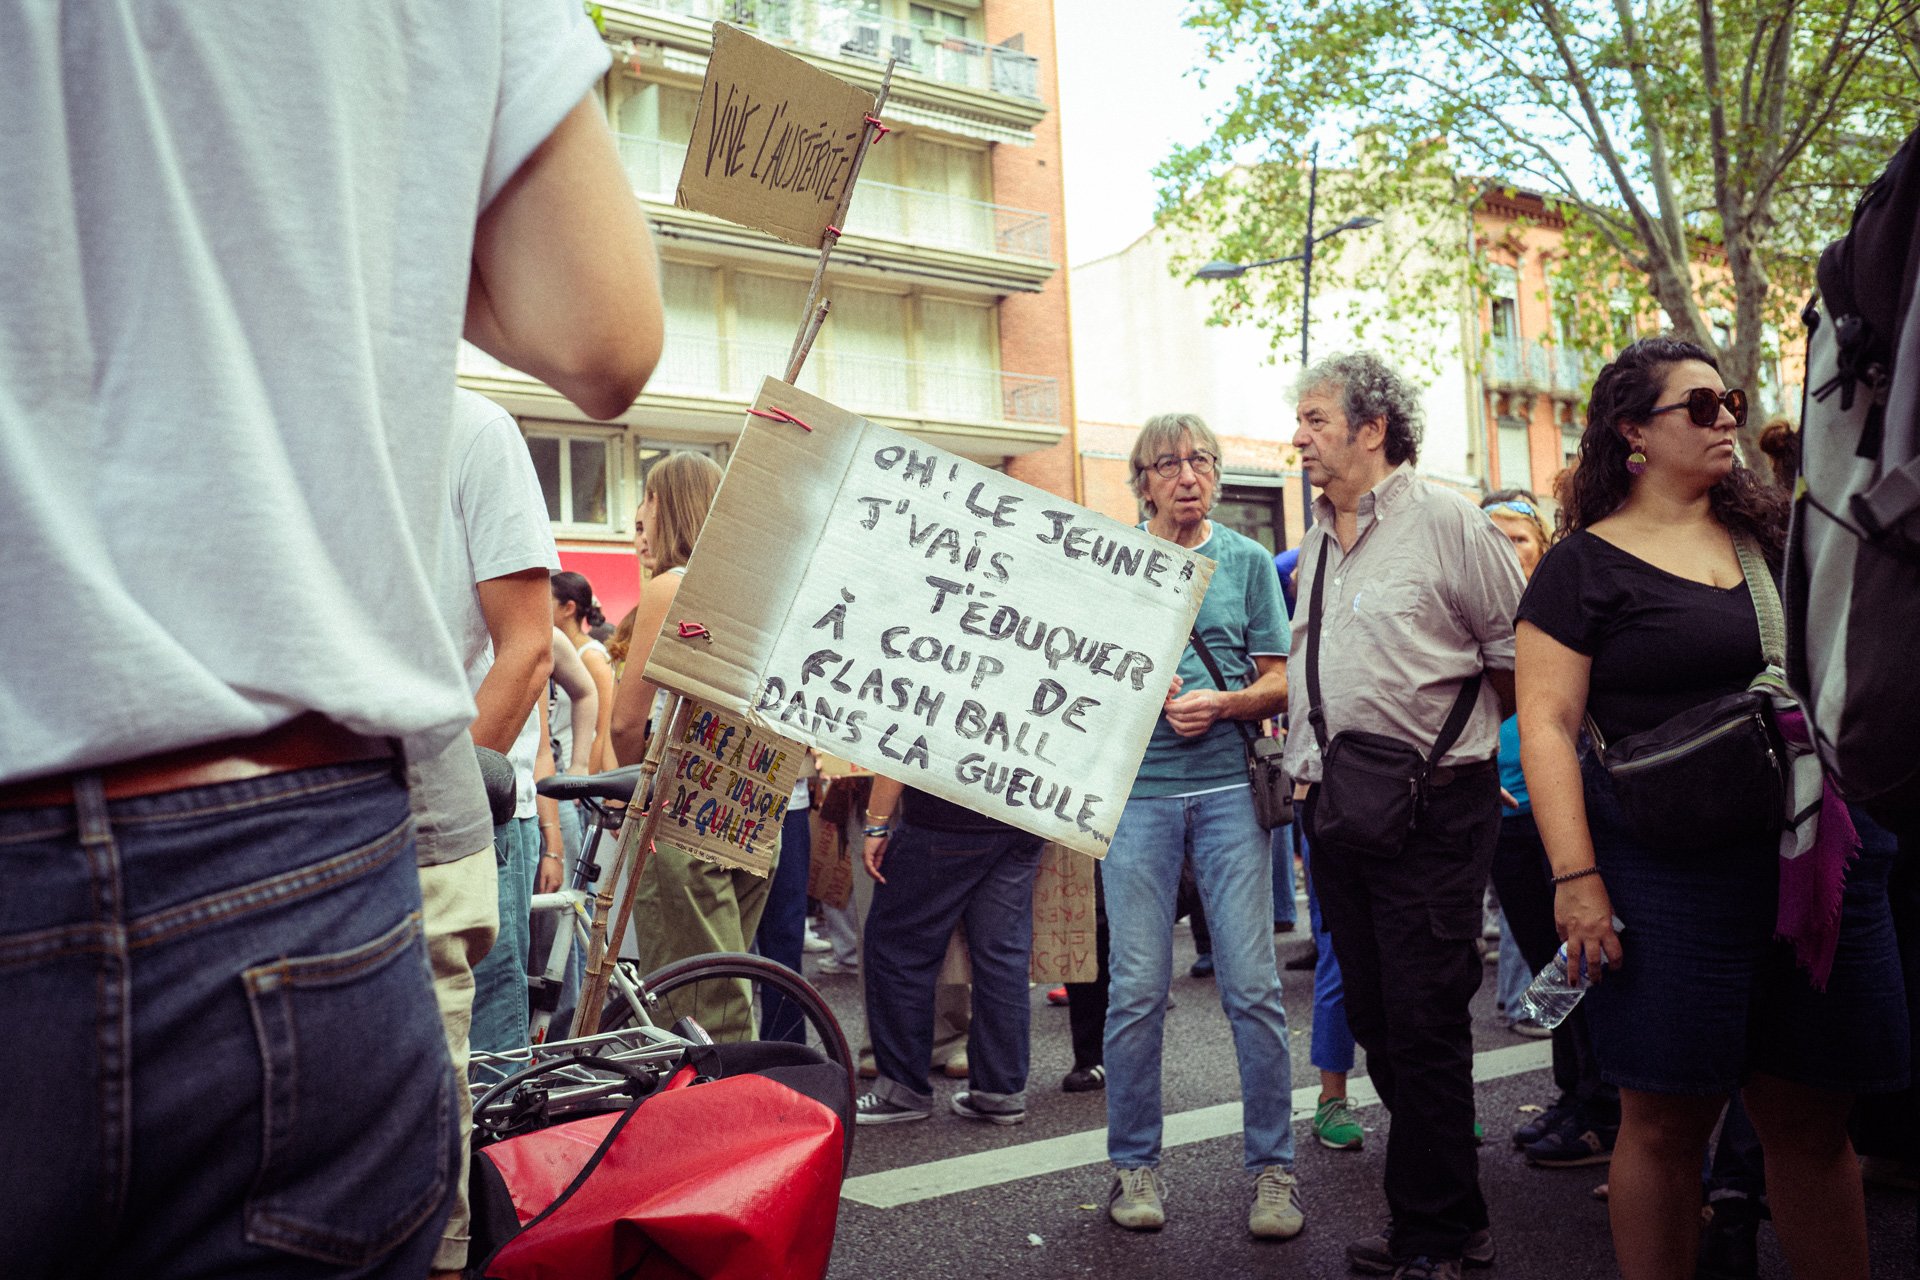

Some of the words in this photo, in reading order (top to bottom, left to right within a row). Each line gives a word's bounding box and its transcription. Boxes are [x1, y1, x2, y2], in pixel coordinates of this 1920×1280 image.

[965, 482, 1024, 528] LE
[812, 587, 856, 640] À
[880, 626, 1005, 690] COUP
[1027, 678, 1101, 734] DE
[755, 676, 868, 744] DANS
[878, 723, 929, 770] LA
[801, 649, 946, 727] FLASH
[955, 699, 1056, 767] BALL
[728, 725, 752, 767] À
[748, 740, 787, 784] UNE
[668, 784, 699, 827] DE
